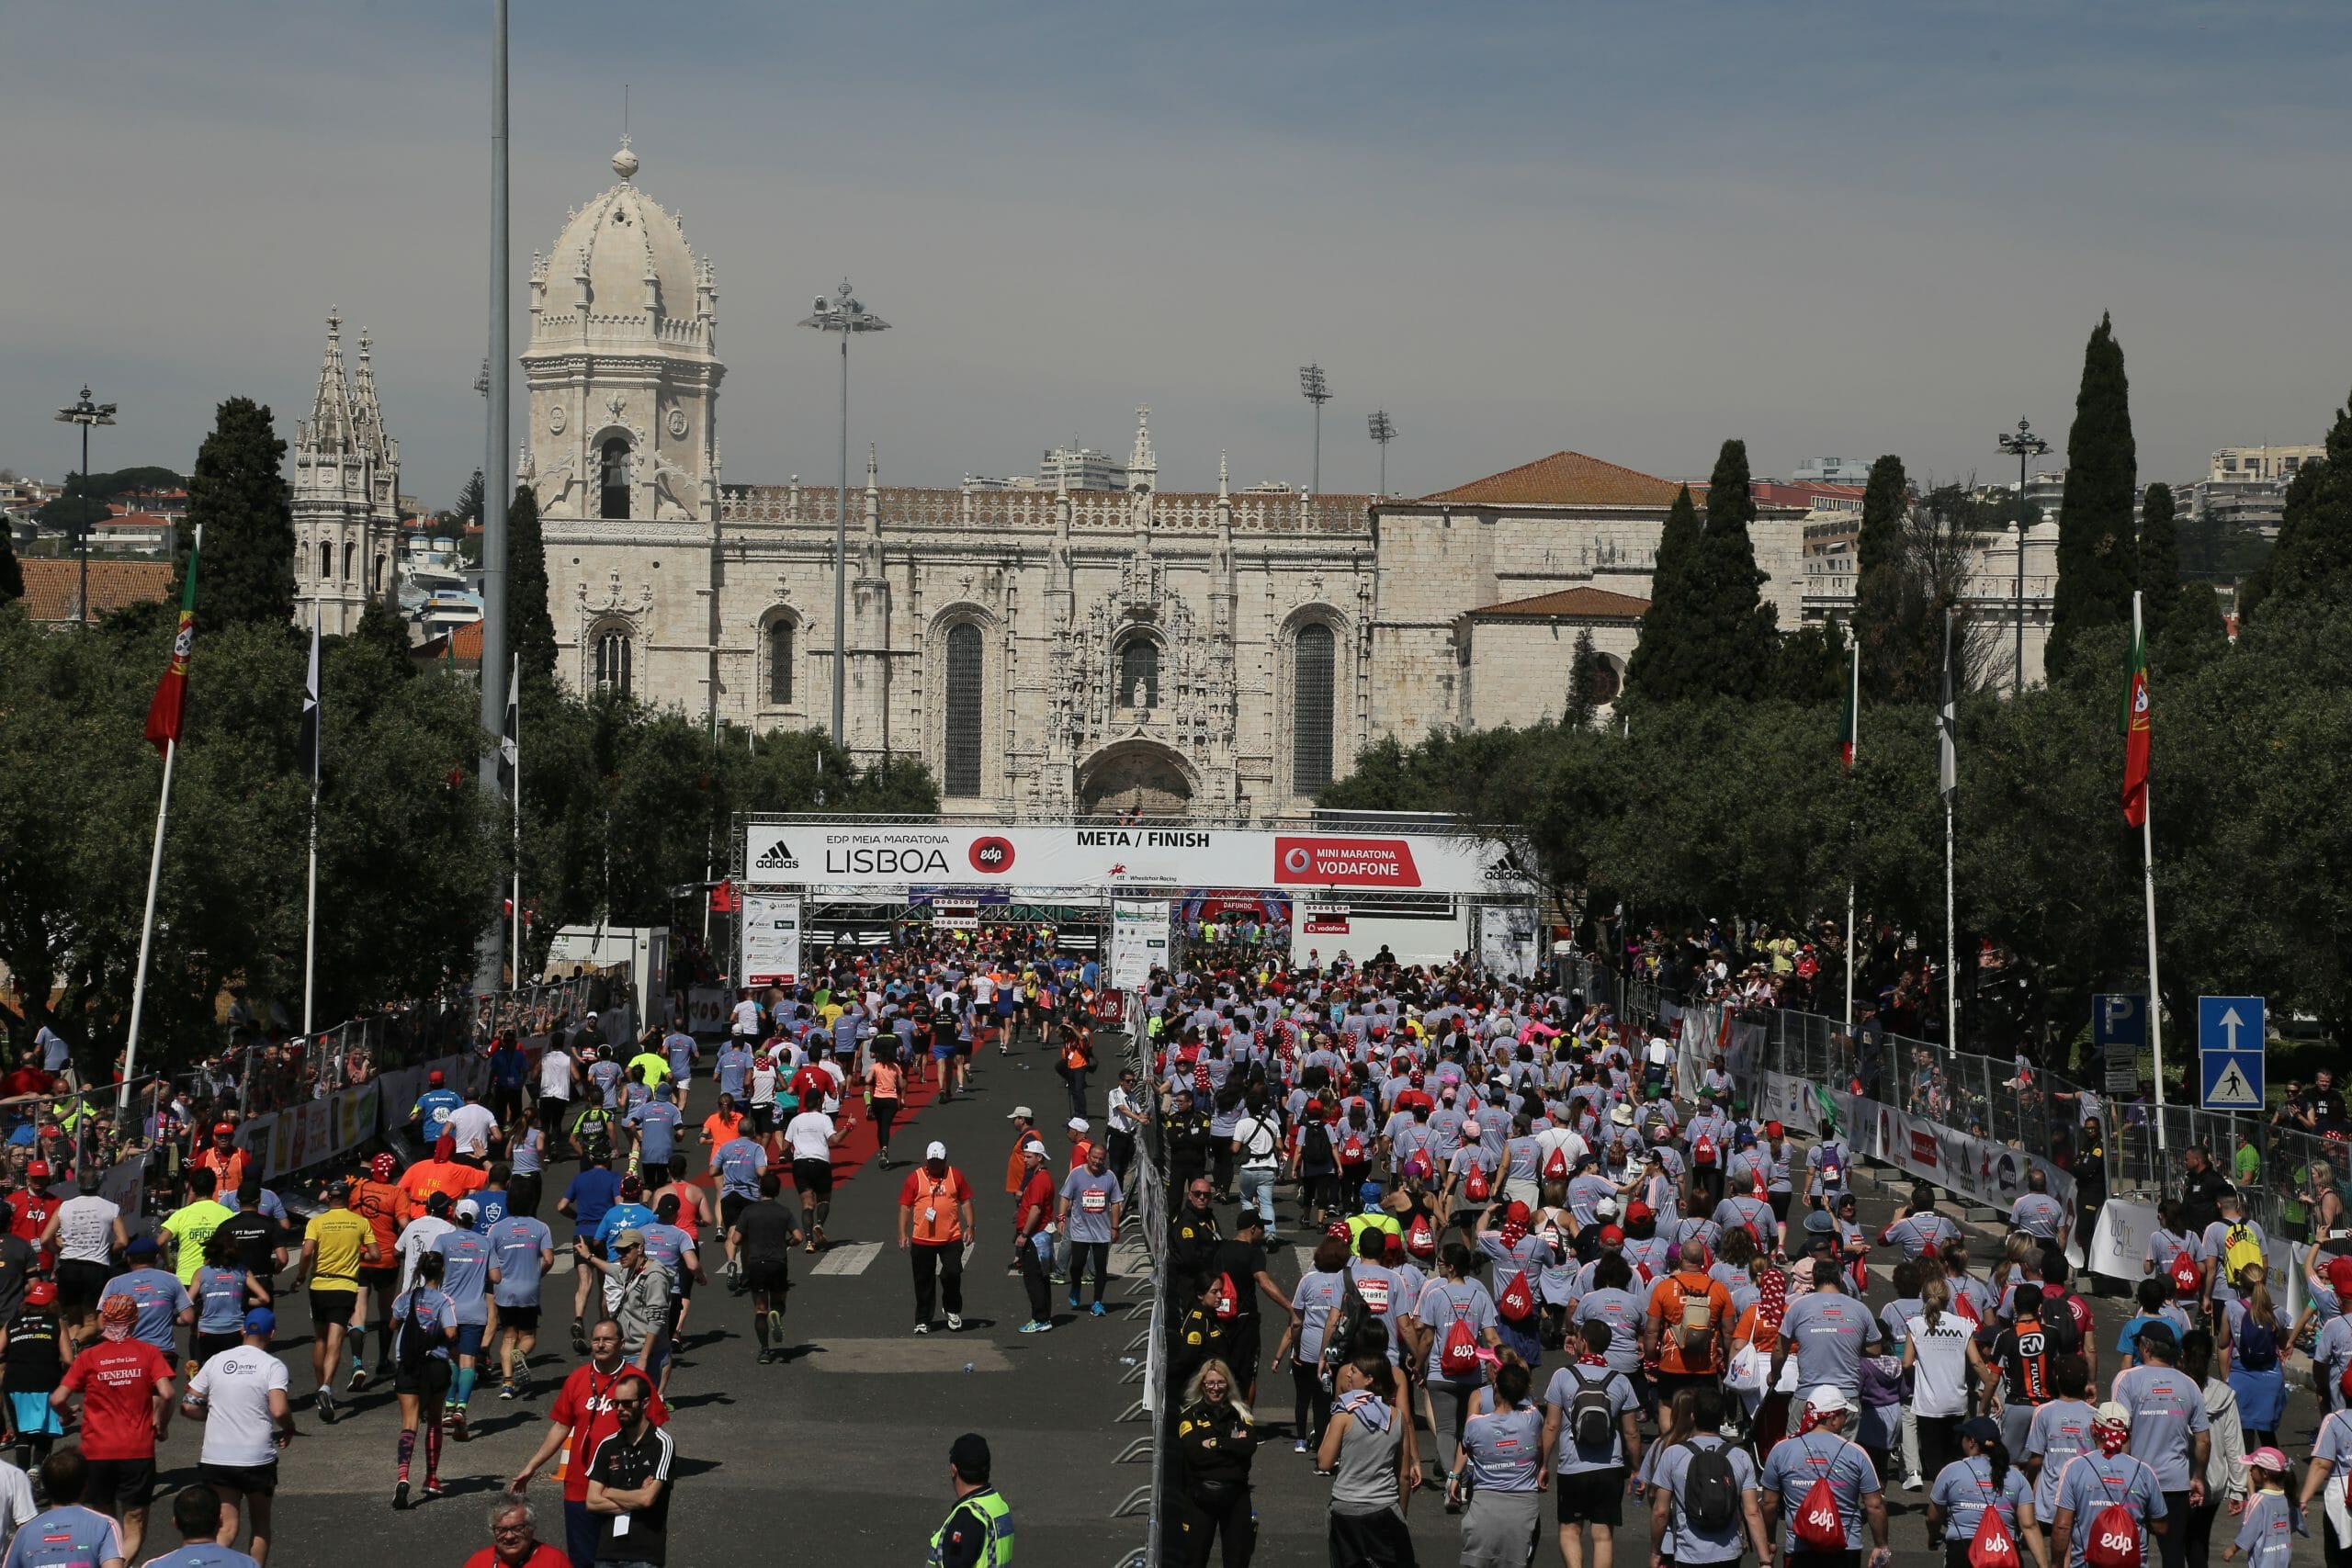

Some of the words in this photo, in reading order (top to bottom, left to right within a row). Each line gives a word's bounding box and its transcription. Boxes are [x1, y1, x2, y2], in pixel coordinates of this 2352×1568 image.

[827, 835, 849, 844] EDP
[853, 835, 880, 844] MEIA
[884, 835, 949, 844] MARATONA
[1077, 831, 1130, 847] META
[1148, 832, 1210, 848] FINISH
[827, 849, 949, 874] LISBOA
[980, 847, 1002, 863] edp
[1317, 849, 1339, 858] MINI
[1340, 850, 1396, 860] MARATONA
[755, 859, 799, 869] adidas
[1317, 862, 1399, 875] VODAFONE
[1485, 870, 1527, 880] adidas
[2105, 997, 2133, 1035] P
[427, 1179, 441, 1187] THE
[1453, 1344, 1475, 1359] edp
[97, 1369, 141, 1381] GENERALI
[1808, 1507, 1835, 1532] edp
[1984, 1533, 2009, 1556] edp
[2100, 1531, 2132, 1556] edp
